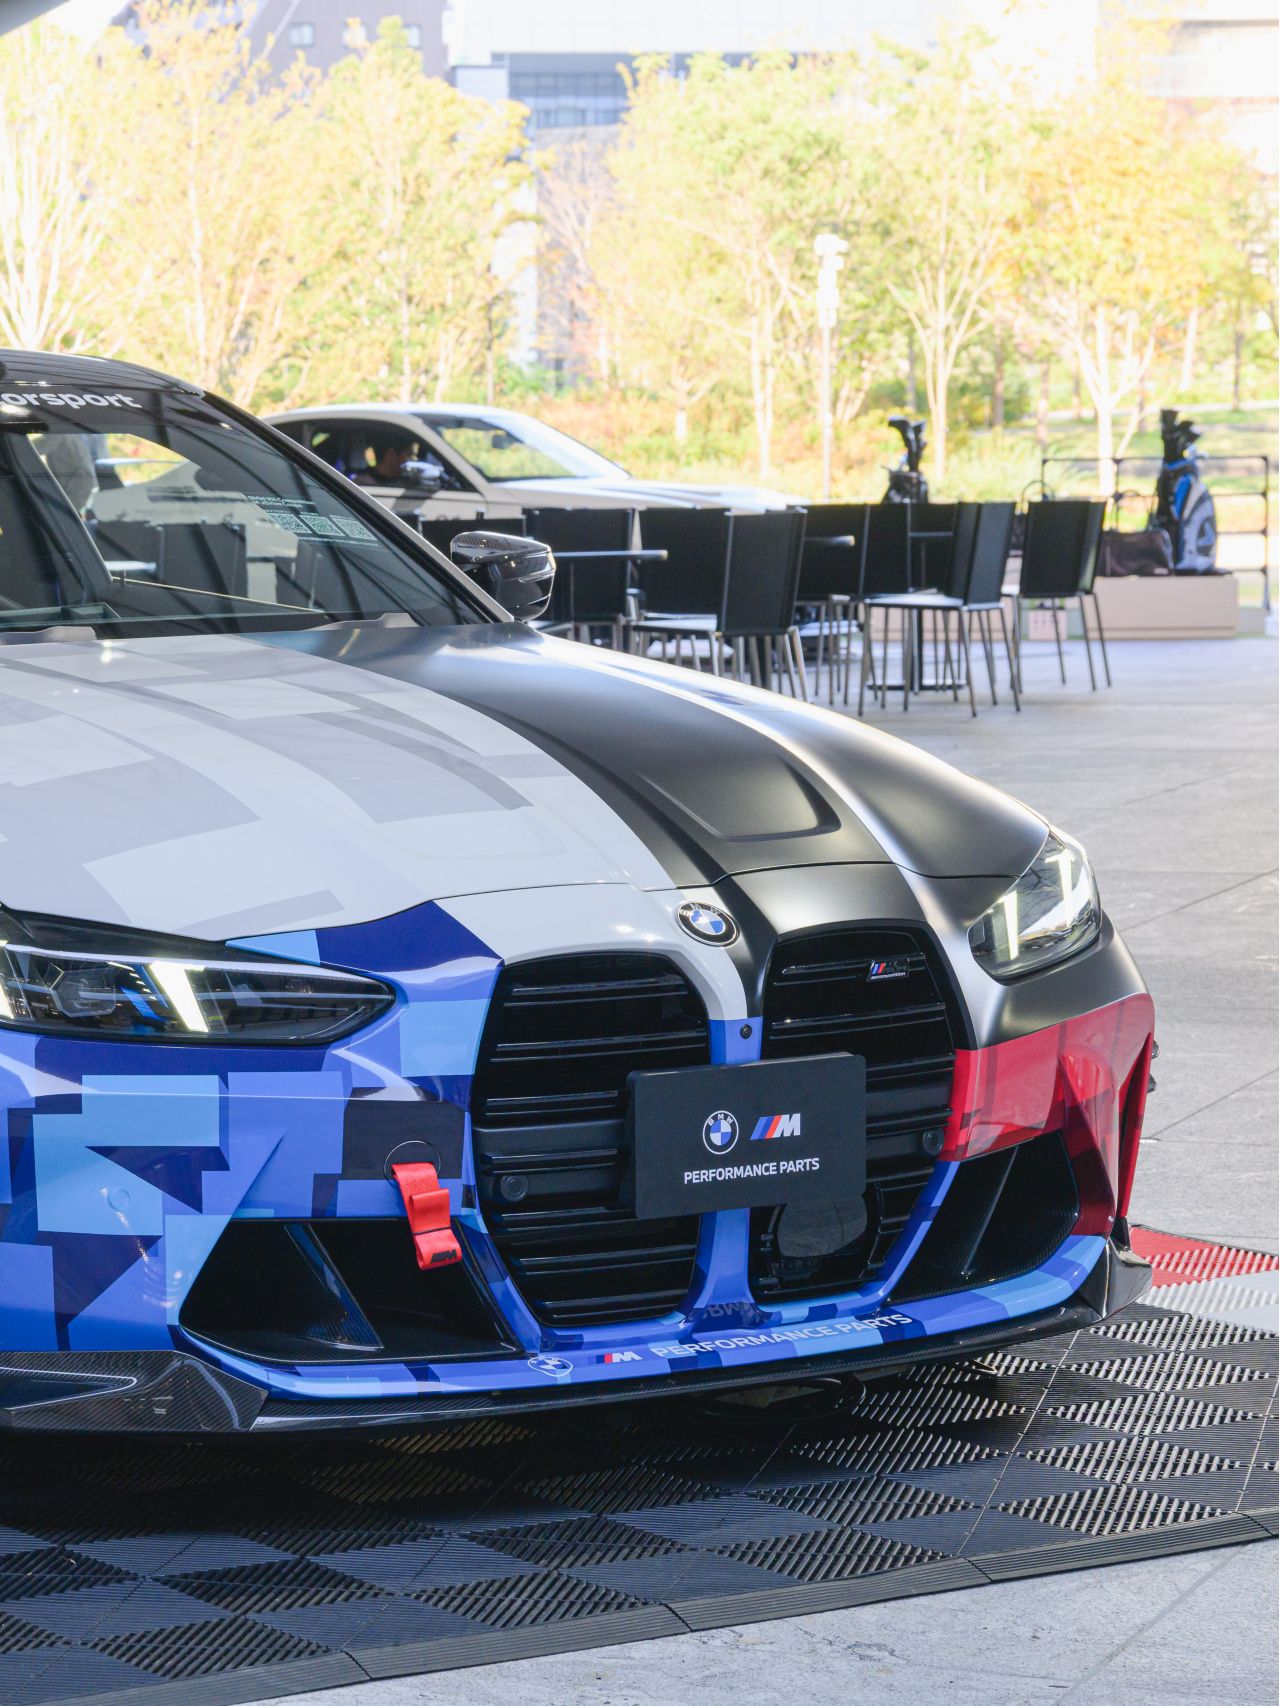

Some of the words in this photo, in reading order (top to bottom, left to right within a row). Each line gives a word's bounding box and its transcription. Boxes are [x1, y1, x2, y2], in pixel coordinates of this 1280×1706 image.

[707, 1113, 734, 1126] BMW
[683, 1161, 777, 1184] PERFORMANCE
[779, 1157, 820, 1174] PARTS
[649, 1322, 839, 1358] PERFORMANCE
[839, 1313, 914, 1334] PARTS
